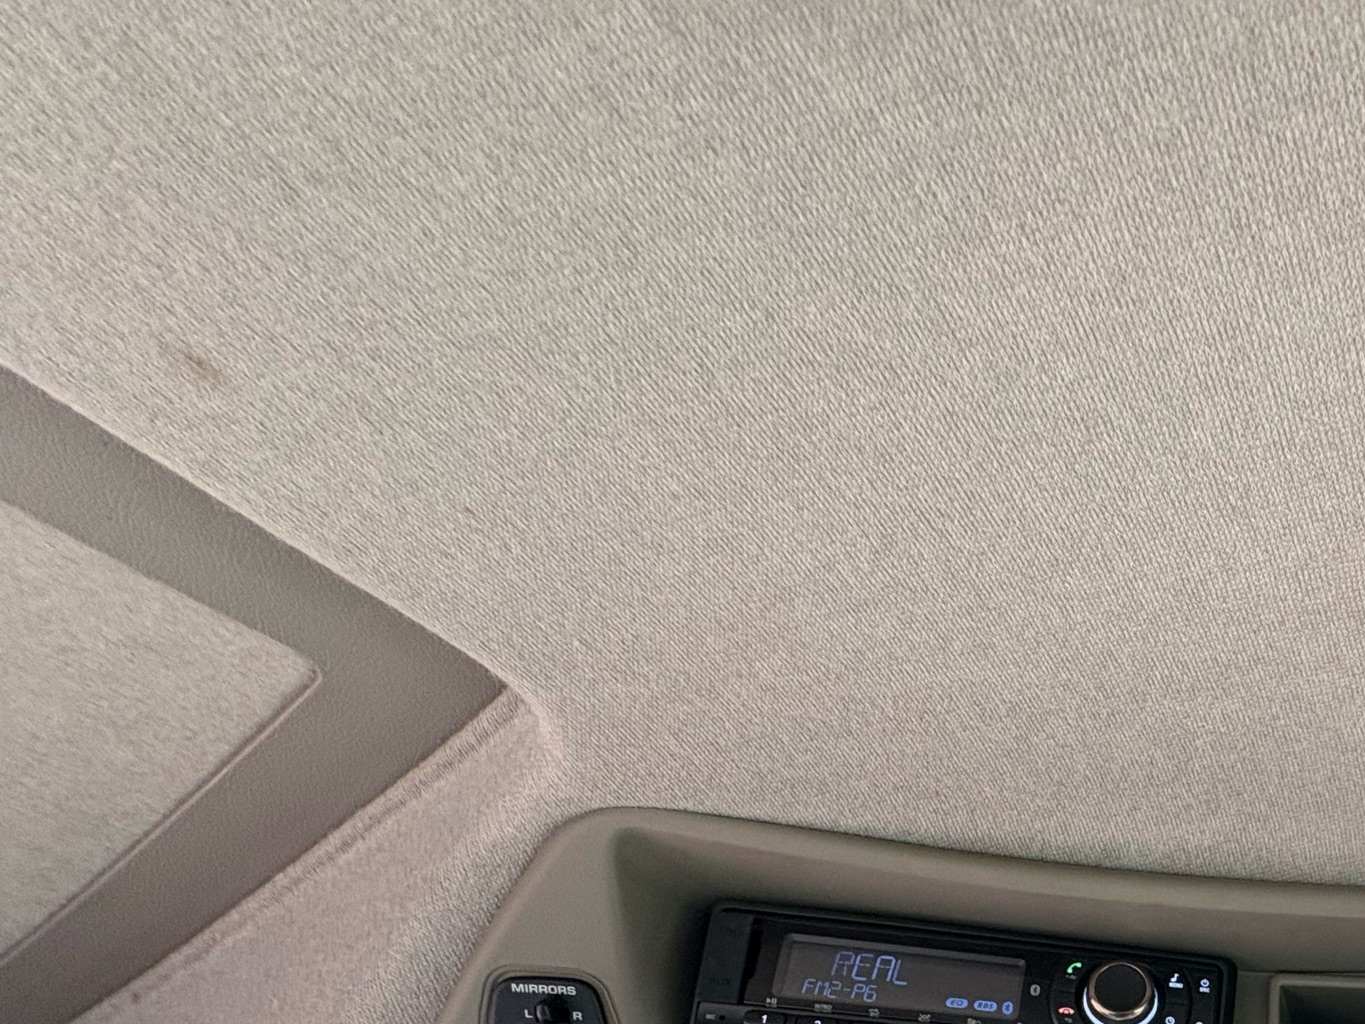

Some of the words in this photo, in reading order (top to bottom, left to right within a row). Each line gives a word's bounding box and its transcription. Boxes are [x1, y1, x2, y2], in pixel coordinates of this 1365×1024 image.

[831, 951, 908, 985] REAL
[510, 983, 577, 996] MIRRORS
[801, 978, 878, 1003] FM2-P6
[524, 1009, 533, 1019] L
[572, 1011, 583, 1021] R
[761, 1014, 768, 1024] 1
